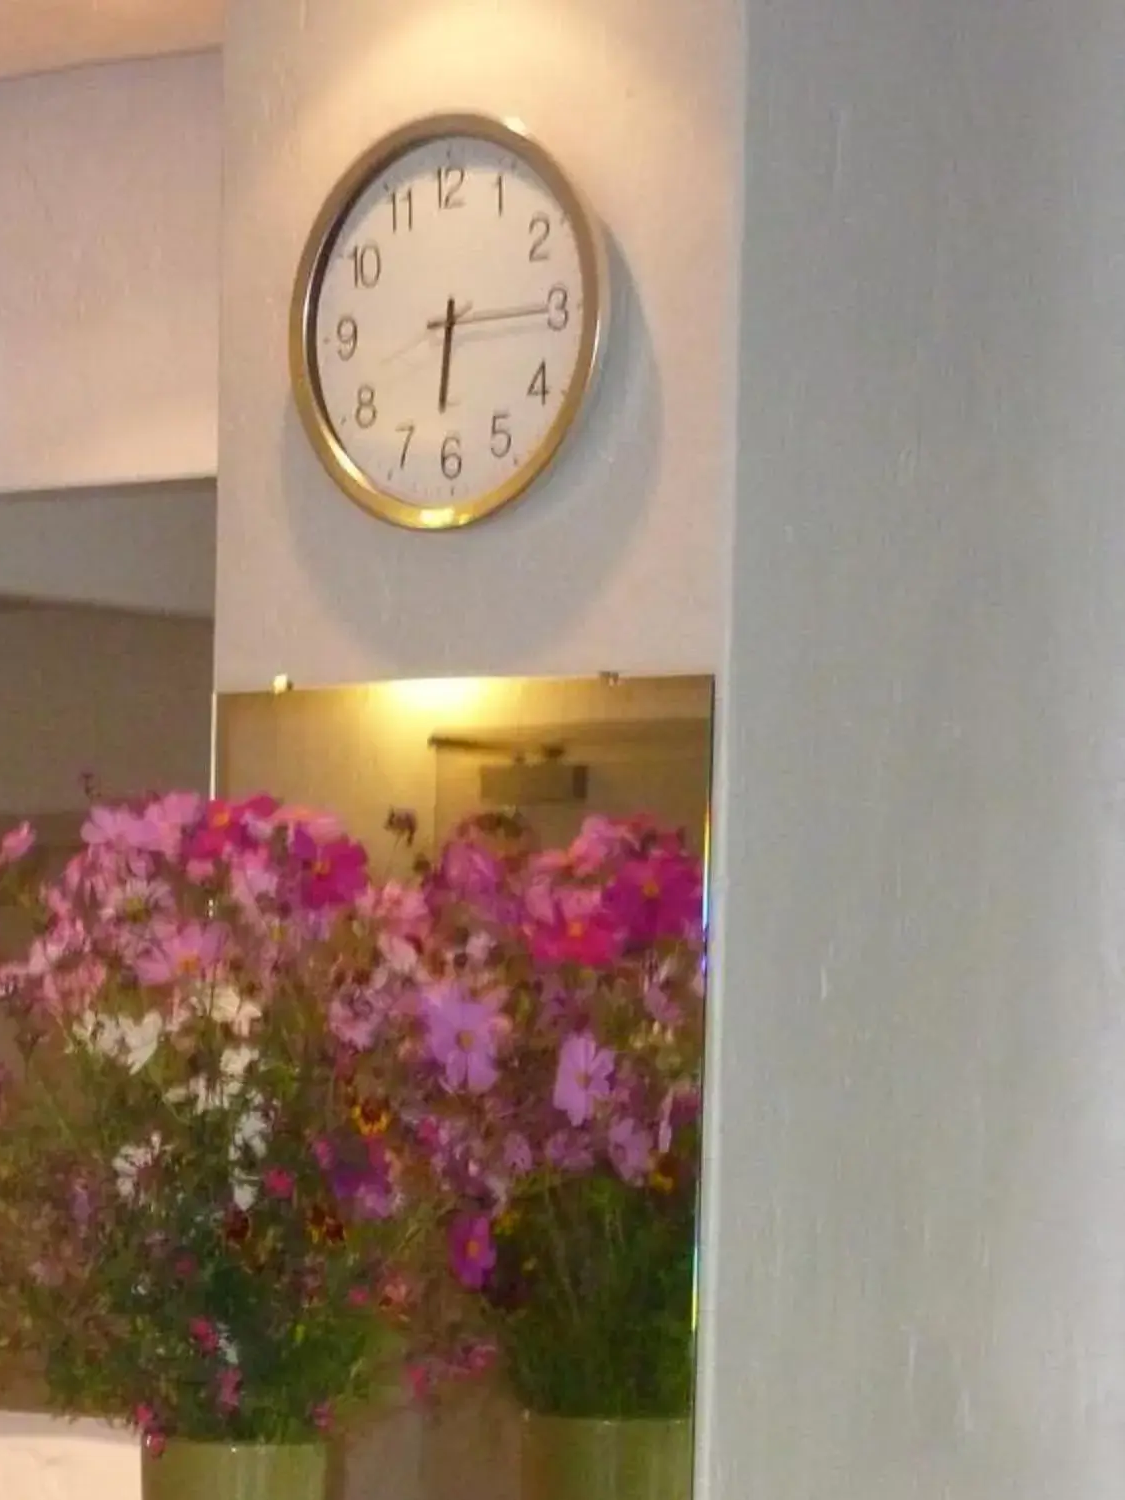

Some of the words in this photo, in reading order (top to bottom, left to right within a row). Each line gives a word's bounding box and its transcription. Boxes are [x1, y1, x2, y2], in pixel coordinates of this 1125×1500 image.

[437, 168, 465, 209] 12
[495, 176, 504, 218] 1
[390, 190, 413, 233] 11
[528, 217, 550, 262] 2
[352, 245, 381, 289] 10
[546, 287, 569, 331] 3
[336, 316, 358, 361] 9
[527, 361, 550, 406] 4
[354, 385, 378, 429] 8
[396, 425, 415, 470] 7
[490, 413, 512, 458] 5
[440, 436, 462, 481] 6
